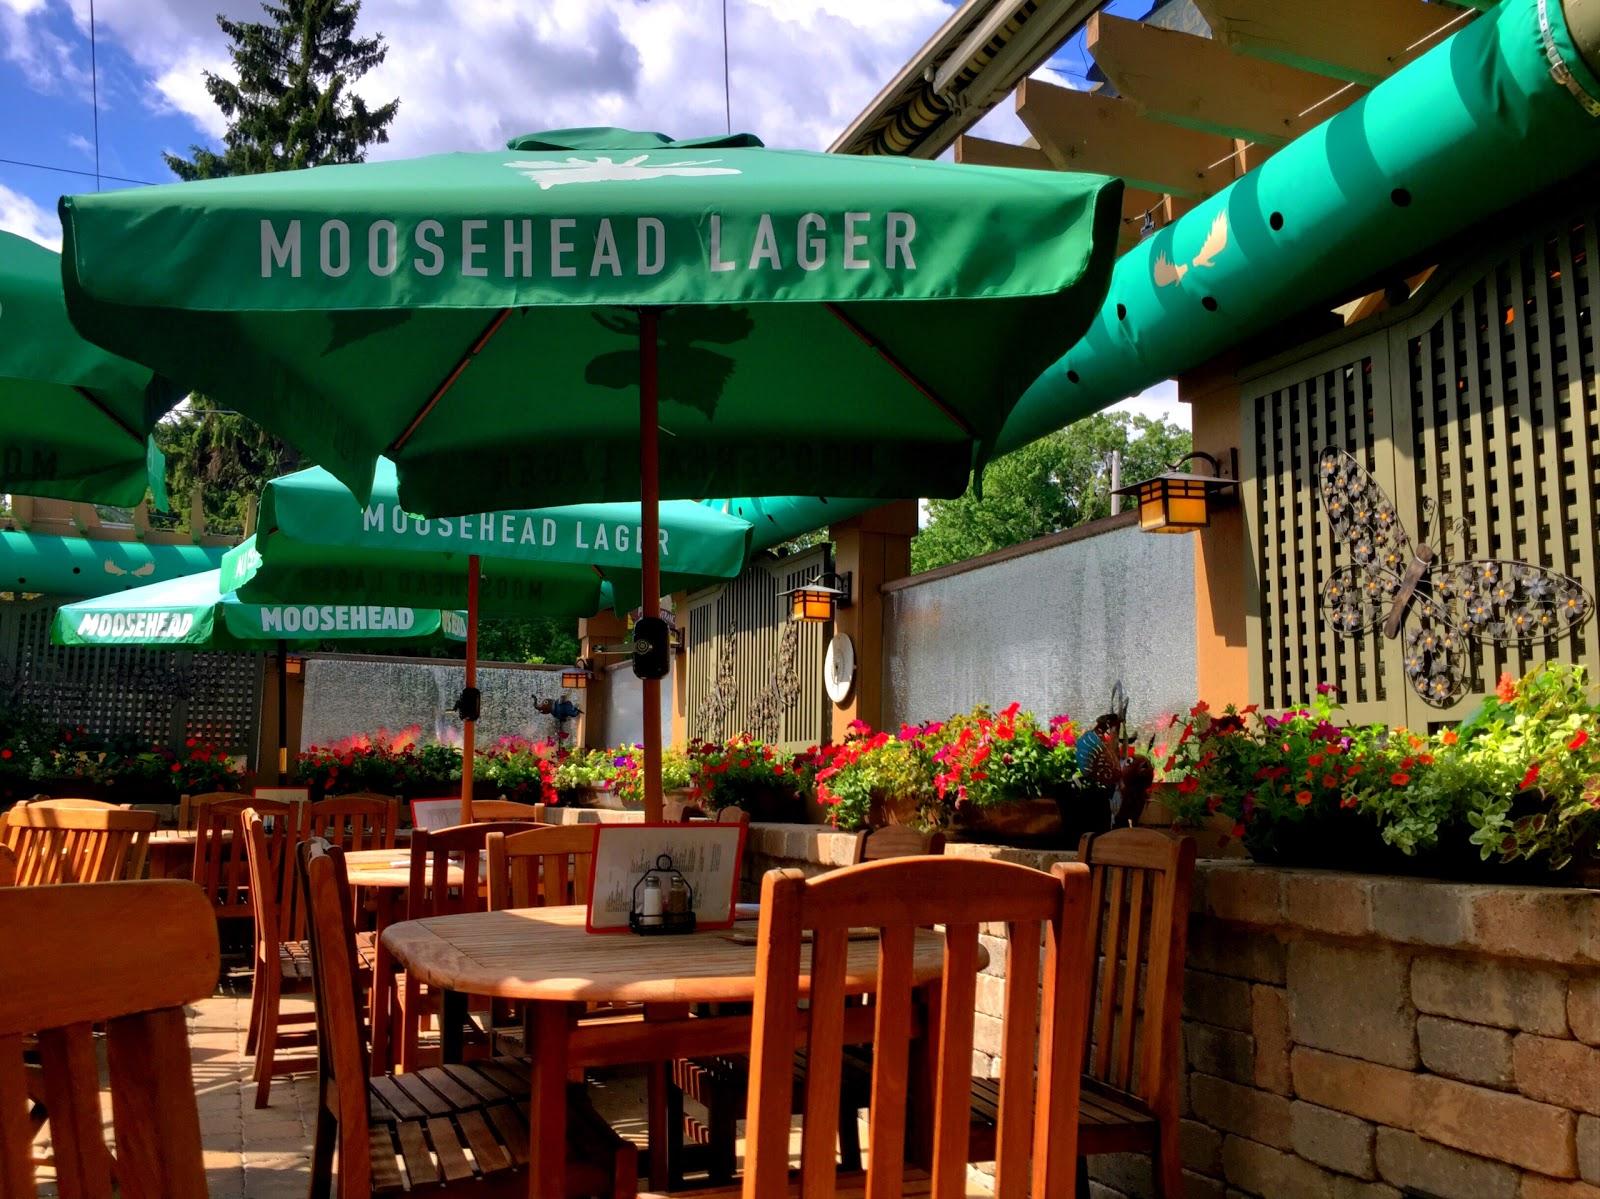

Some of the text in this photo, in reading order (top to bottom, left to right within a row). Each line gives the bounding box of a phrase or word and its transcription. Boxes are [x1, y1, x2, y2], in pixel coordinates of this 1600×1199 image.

[260, 212, 917, 278] MOOSEHEAD LAGER
[77, 611, 194, 638] MOOSEHEAD
[260, 606, 414, 632] MOOSEHEAD
